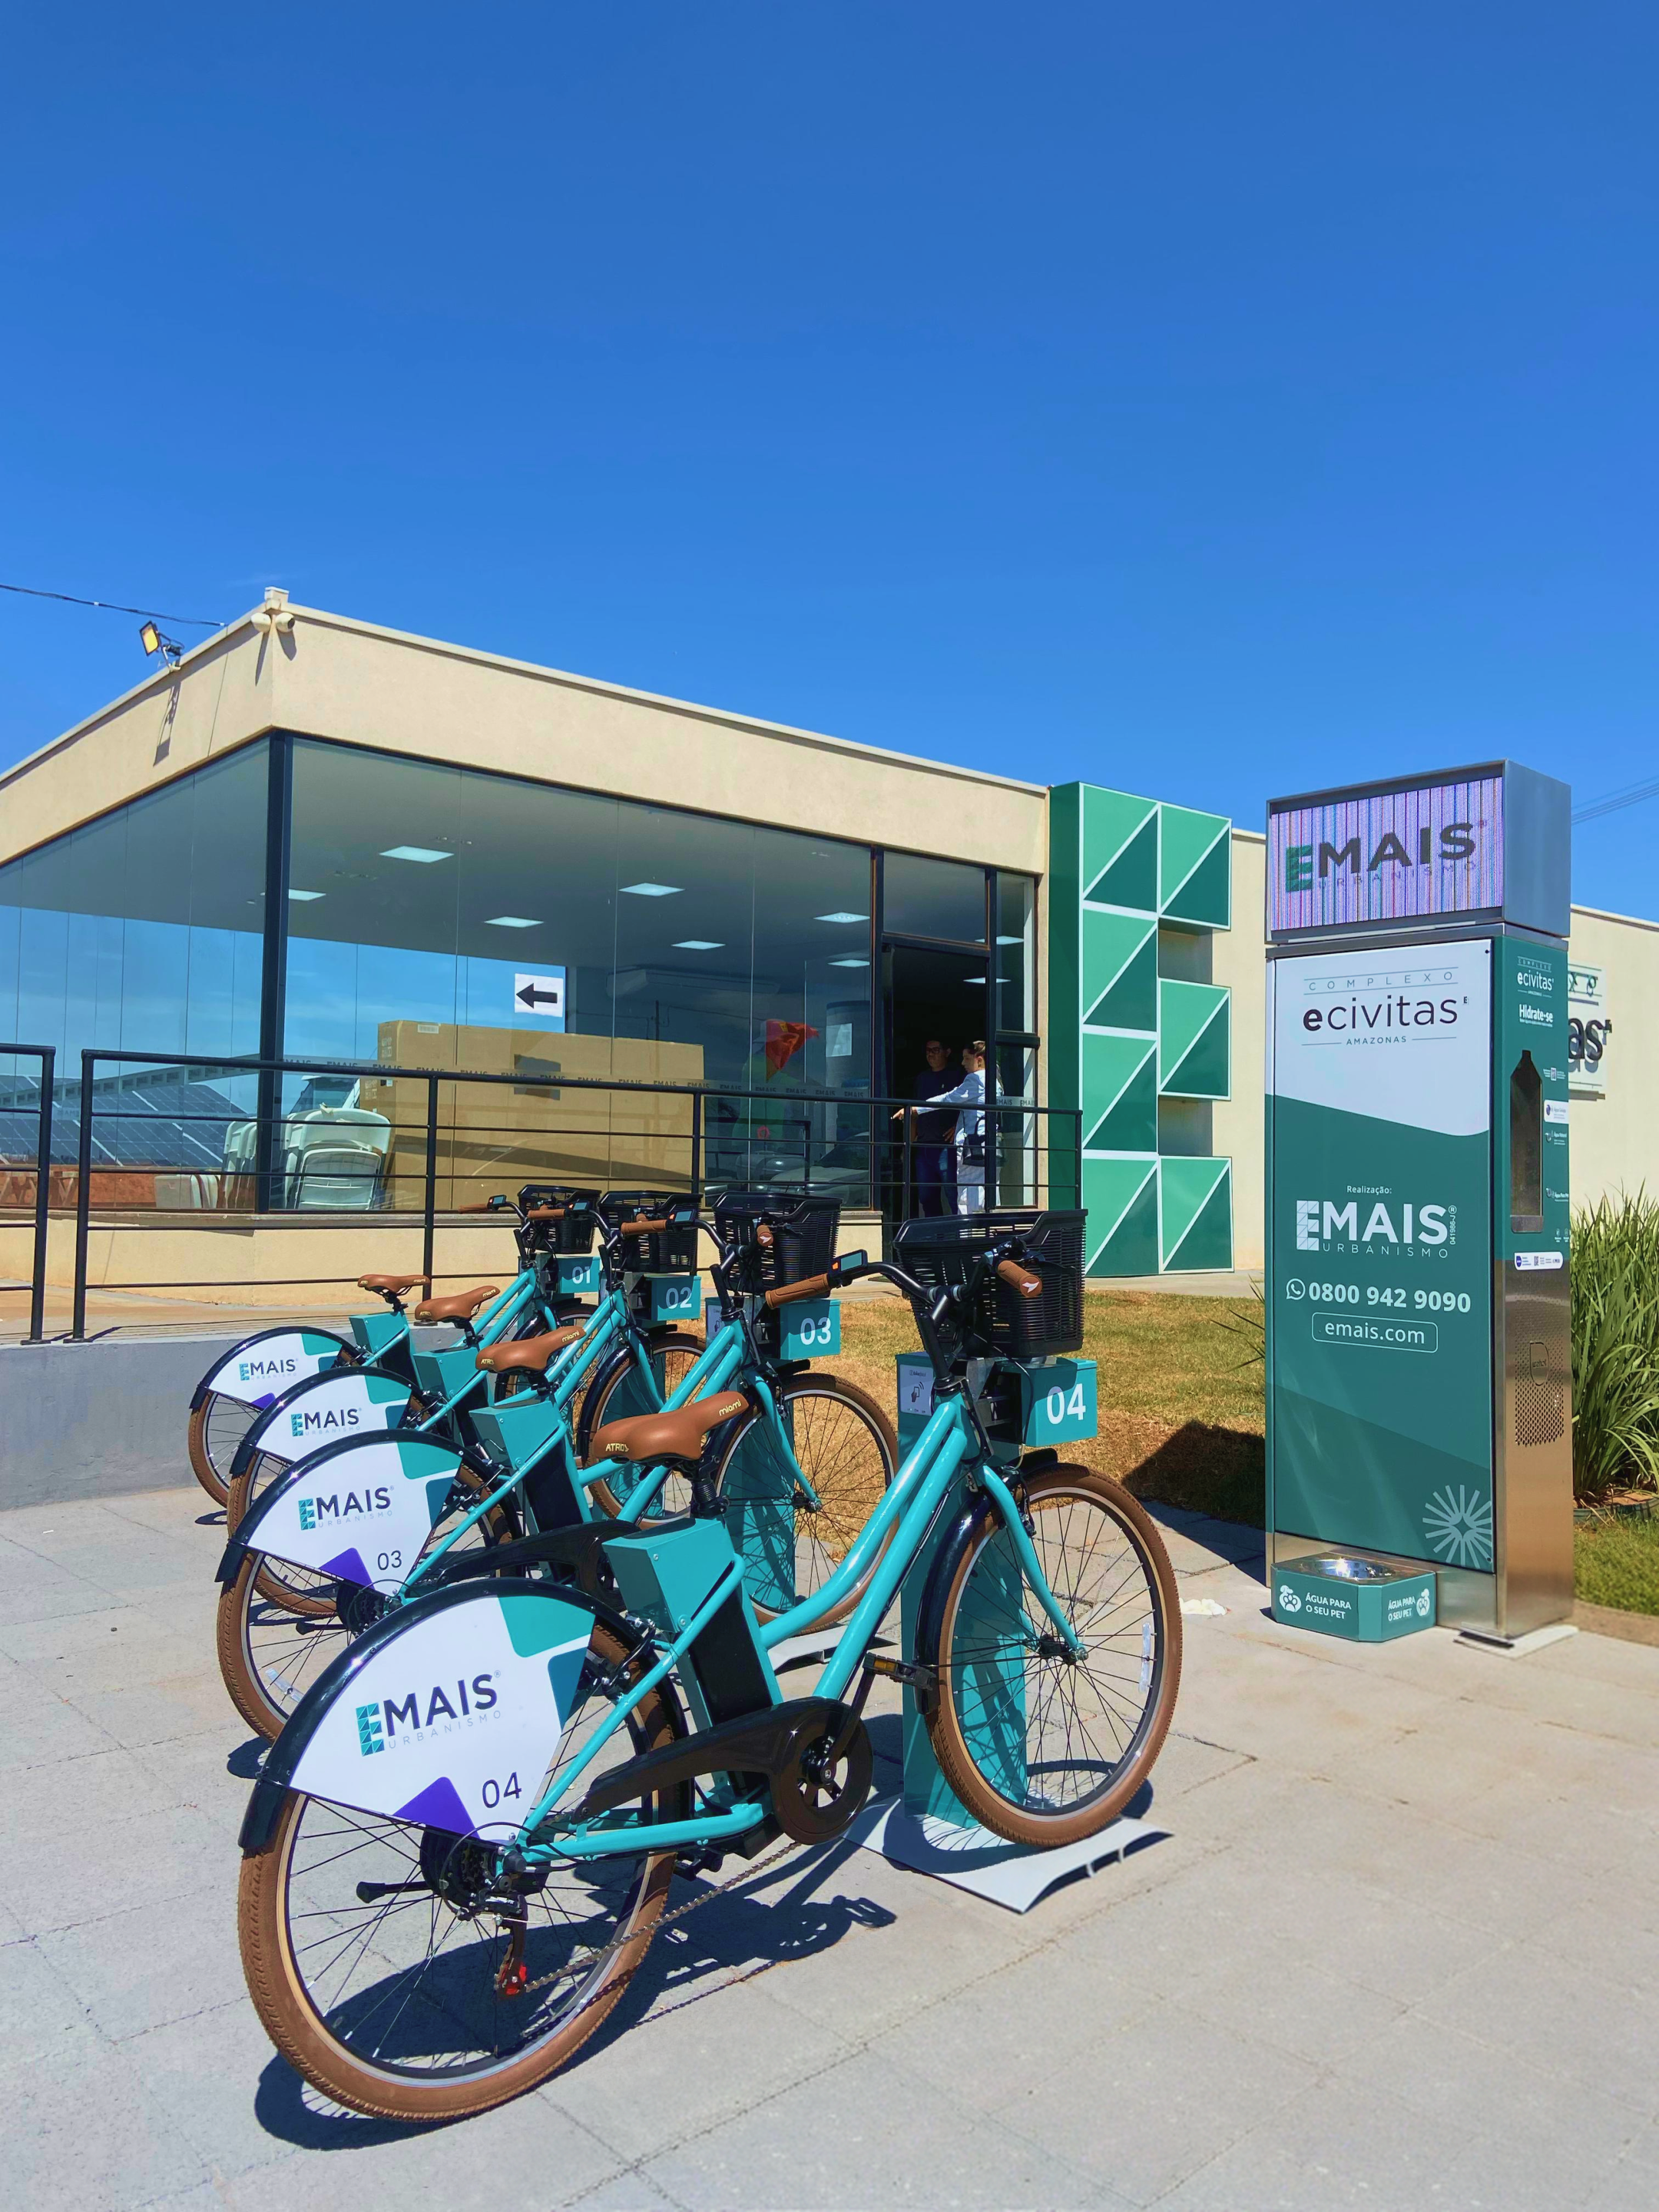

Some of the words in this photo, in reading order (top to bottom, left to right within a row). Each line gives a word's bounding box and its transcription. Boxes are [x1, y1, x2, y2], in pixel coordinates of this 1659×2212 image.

[1286, 823, 1475, 892] EMAIS
[1309, 971, 1452, 991] COMPLEXO
[1517, 969, 1552, 992] ecivitas
[1303, 995, 1458, 1031] ecivitas
[1519, 1004, 1553, 1022] Hidrate-se
[1346, 1036, 1406, 1045] AMAZONAS
[1346, 1185, 1392, 1195] Realização:
[1296, 1200, 1448, 1251] EMAIS
[1323, 1243, 1448, 1259] URBANISMO
[571, 1266, 591, 1284] 01
[666, 1286, 693, 1310] 02
[1309, 1282, 1359, 1304] 0800
[1366, 1286, 1407, 1308] 942
[1414, 1290, 1471, 1313] 9090
[561, 1330, 580, 1343] miami
[800, 1317, 832, 1346] 03
[1325, 1322, 1425, 1344] emais.com
[239, 1359, 296, 1381] EMAIS
[719, 1399, 741, 1416] miami
[1046, 1383, 1086, 1425] 04
[290, 1409, 359, 1437] EMAIS
[305, 1426, 361, 1435] URBANISMO
[298, 1487, 392, 1531] EMAIS
[318, 1510, 393, 1528] URBANISMO
[377, 1550, 402, 1571] 03
[1306, 1592, 1328, 1605] ÁGUA
[1330, 1599, 1352, 1610] PARA
[1306, 1604, 1313, 1613] O
[1314, 1607, 1330, 1616] SEU
[1330, 1610, 1346, 1619] PET
[1388, 1599, 1402, 1611] ÁGUA
[1402, 1596, 1416, 1608] PARA
[1388, 1613, 1392, 1621] O
[1392, 1611, 1402, 1621] SEU
[1402, 1608, 1412, 1618] PET
[356, 1674, 498, 1757] EMAIS
[389, 1710, 501, 1750] URBANISMO
[482, 1772, 522, 1809] 04
